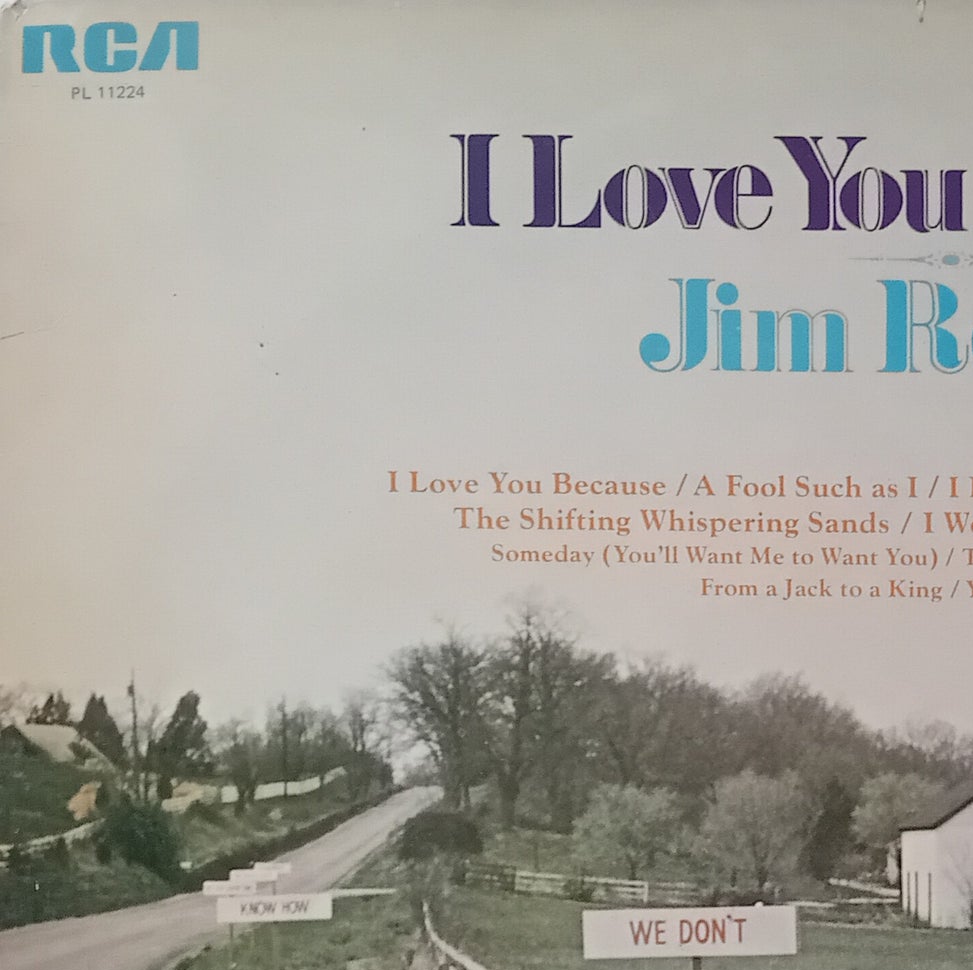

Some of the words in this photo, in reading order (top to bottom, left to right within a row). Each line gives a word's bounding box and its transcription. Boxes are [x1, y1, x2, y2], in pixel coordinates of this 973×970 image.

[22, 21, 199, 74] RCA
[71, 86, 92, 100] PL
[98, 85, 145, 99] 11224
[448, 133, 500, 227] I
[521, 133, 774, 231] Love
[773, 135, 969, 233] You
[638, 277, 855, 373] Jim
[388, 471, 398, 492] I
[409, 471, 478, 493] Love
[488, 472, 542, 494] You
[552, 472, 666, 495] Because
[693, 474, 716, 496] A
[726, 475, 786, 497] Fool
[795, 475, 862, 498] Such
[872, 484, 898, 498] as
[907, 476, 918, 498] I
[950, 477, 959, 498] I
[453, 507, 510, 530] The
[520, 508, 631, 536] Shifting
[640, 509, 799, 538] Whispering
[808, 511, 889, 534] Sands
[924, 512, 934, 534] I
[492, 544, 595, 568] Someday
[603, 545, 678, 568] (You'll
[686, 545, 742, 565] Want
[751, 547, 784, 565] Me
[792, 550, 813, 566] to
[821, 547, 878, 566] Want
[886, 547, 938, 570] You)
[701, 578, 757, 597] From
[766, 584, 778, 597] a
[782, 579, 832, 600] Jack
[841, 583, 862, 597] to
[870, 585, 880, 598] a
[888, 579, 942, 602] King
[241, 902, 276, 915] KNOW
[282, 901, 309, 914] HOW
[629, 920, 667, 945] WE
[679, 914, 747, 945] DON'T
